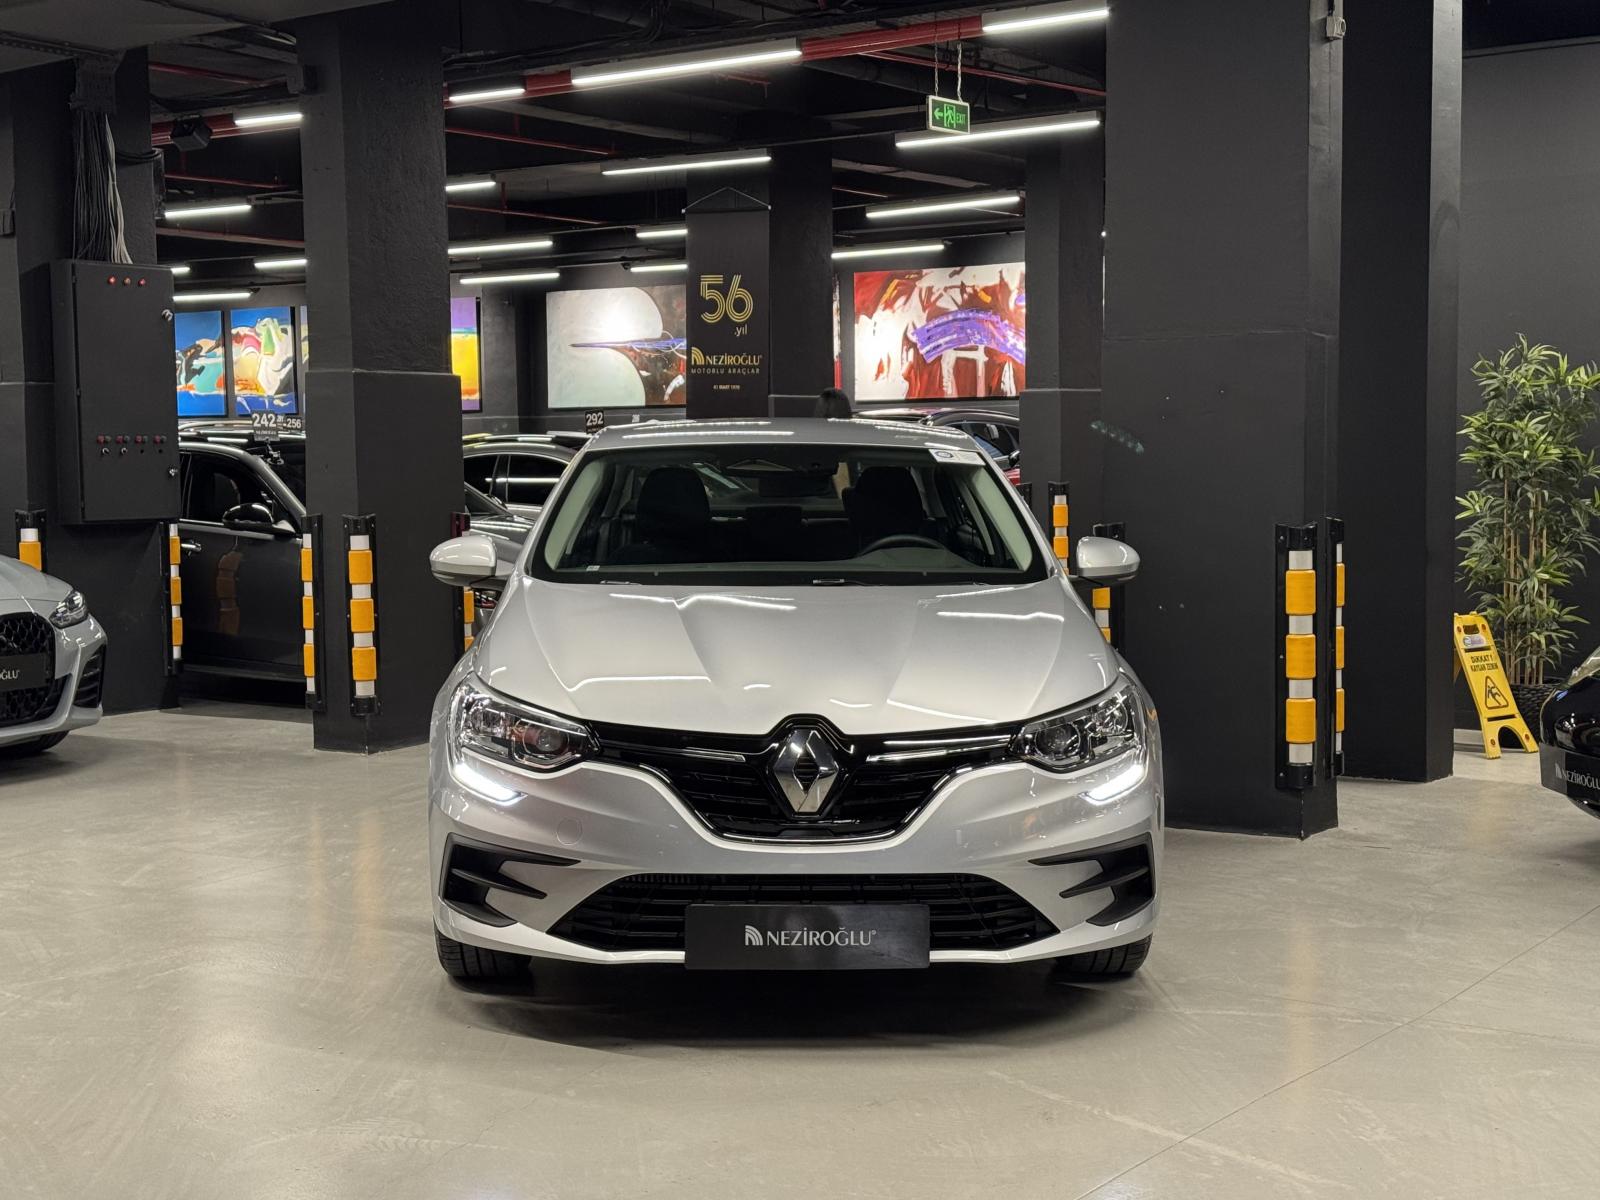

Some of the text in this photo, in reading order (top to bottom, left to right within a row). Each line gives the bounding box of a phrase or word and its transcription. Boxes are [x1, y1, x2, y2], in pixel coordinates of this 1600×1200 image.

[700, 274, 753, 323] 56
[705, 352, 760, 365] NEZİROĞLU
[727, 367, 760, 375] ARAÇLAR
[252, 413, 277, 427] 242
[586, 411, 603, 426] 292
[766, 927, 872, 946] NEZİROĞLU
